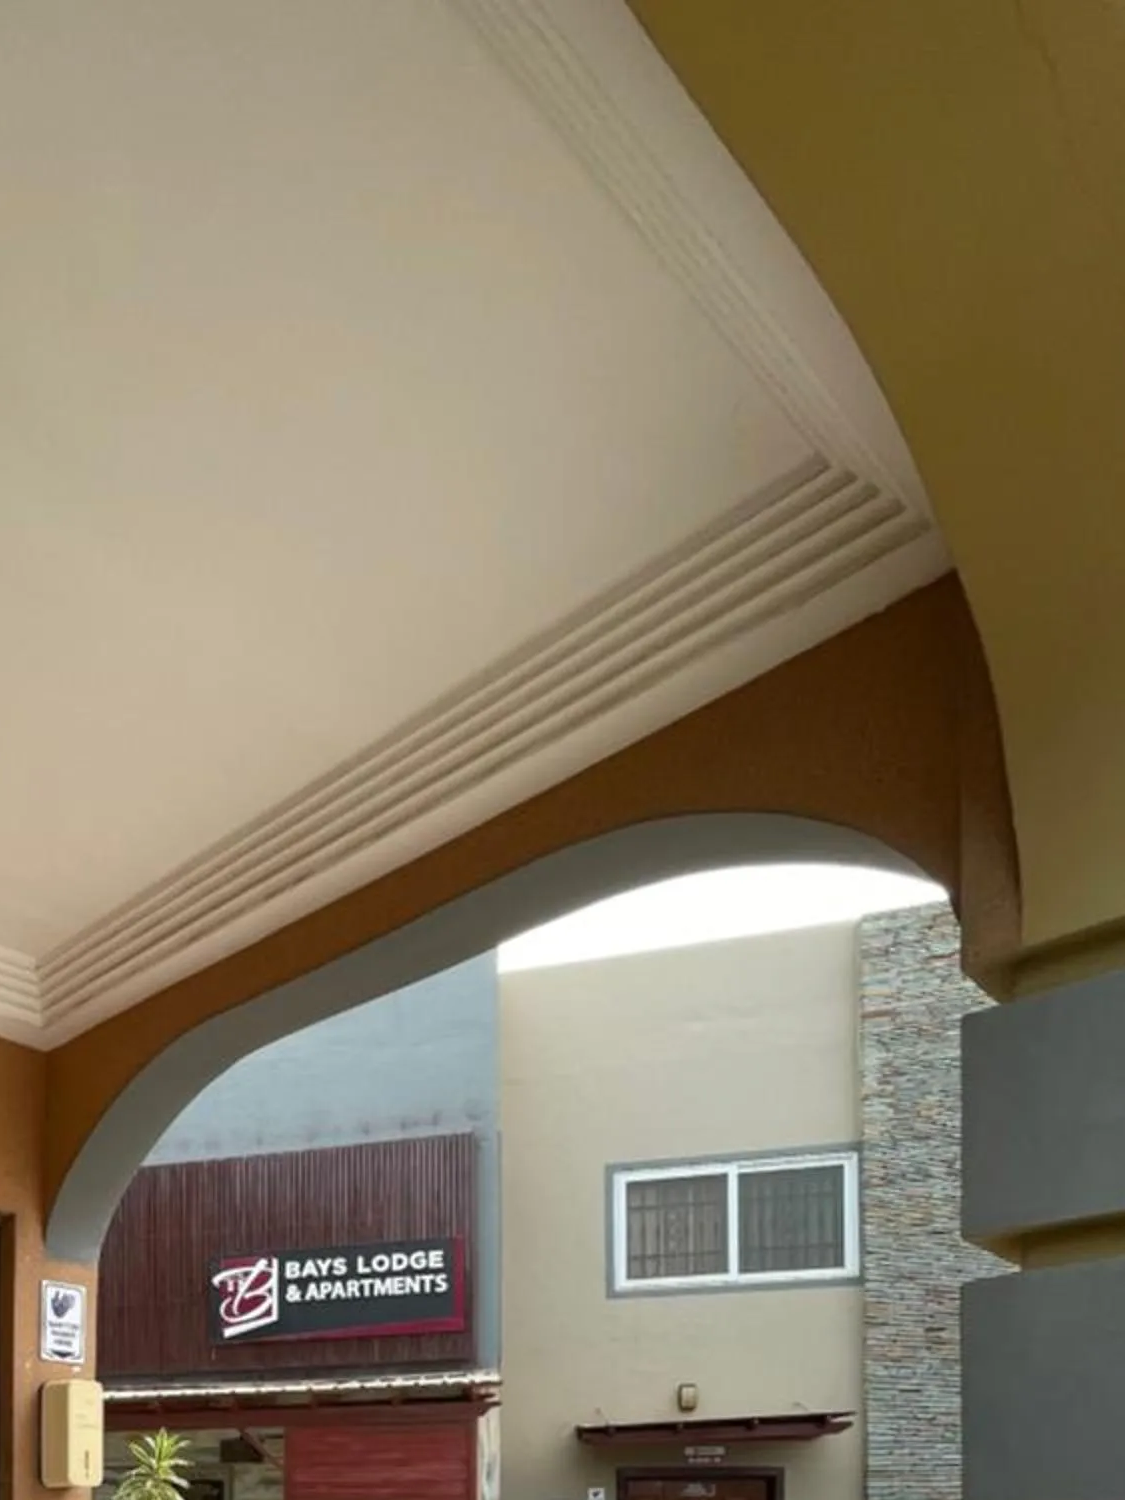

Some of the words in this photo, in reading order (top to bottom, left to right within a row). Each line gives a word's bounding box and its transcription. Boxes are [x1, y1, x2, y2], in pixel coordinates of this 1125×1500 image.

[284, 1257, 348, 1280] BAYS
[357, 1249, 444, 1274] LODGE
[285, 1284, 301, 1302] &
[305, 1273, 448, 1302] APARTMENTS
